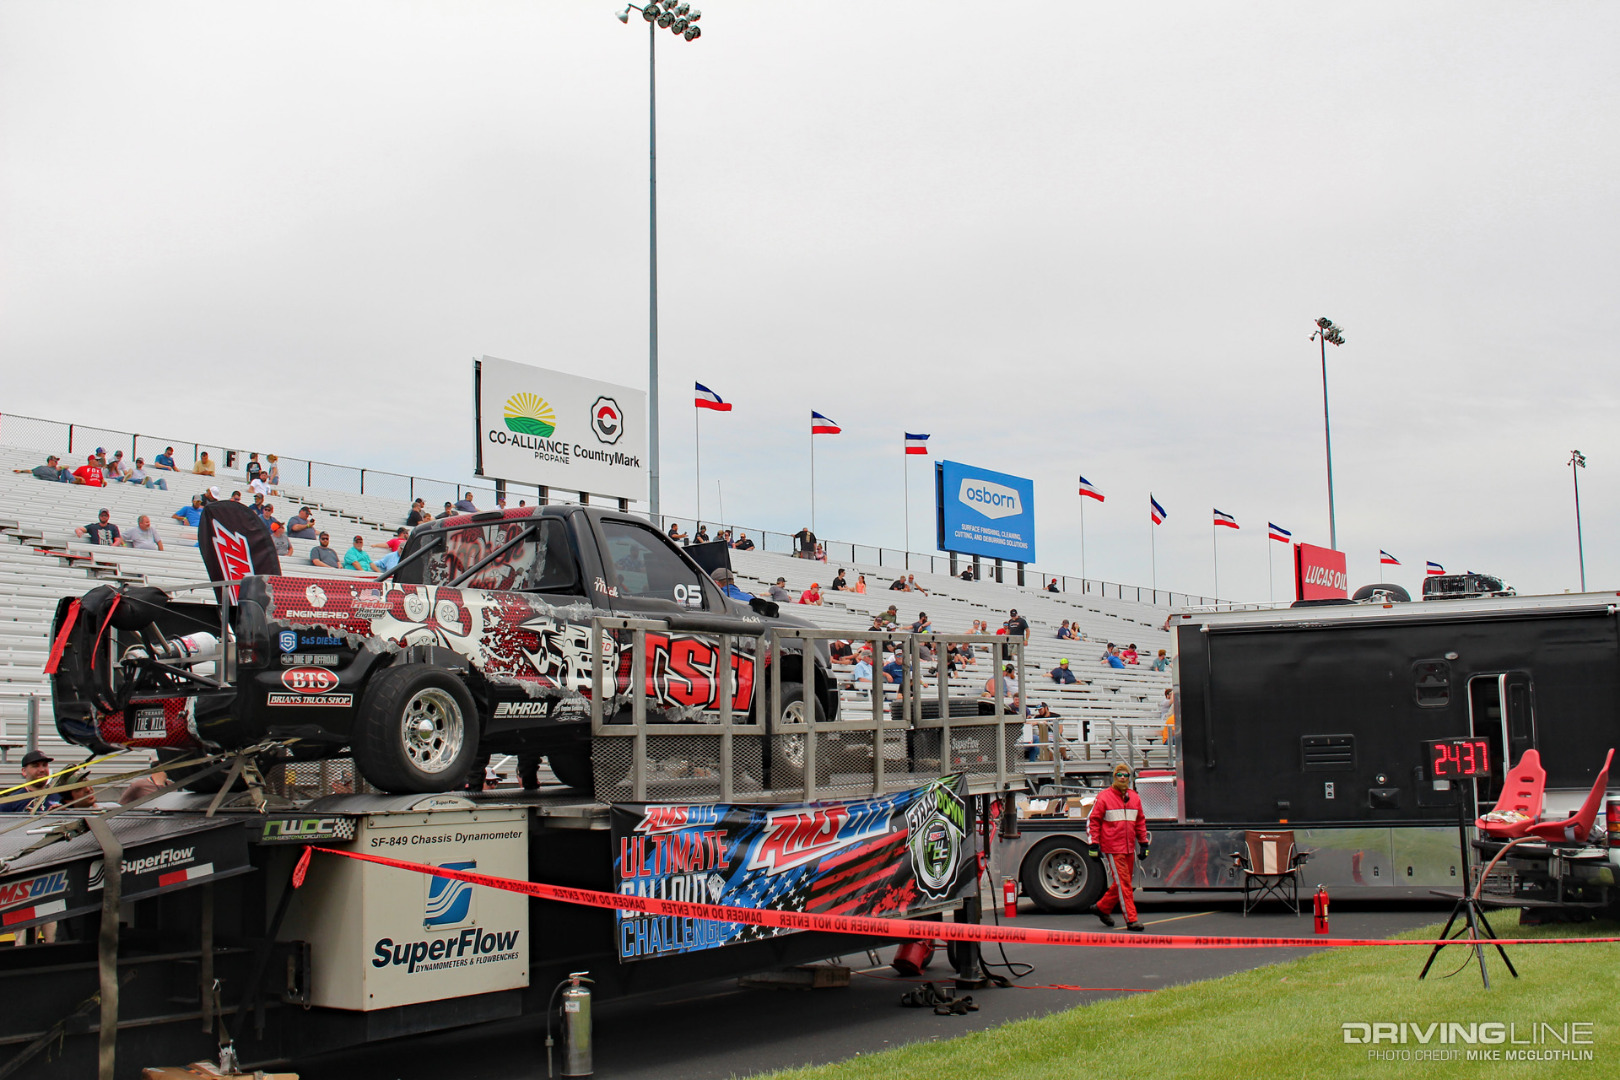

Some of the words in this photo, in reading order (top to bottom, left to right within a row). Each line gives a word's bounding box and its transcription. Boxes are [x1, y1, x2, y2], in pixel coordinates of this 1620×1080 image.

[488, 430, 570, 456] CO-ALLIANCE
[226, 450, 236, 468] F
[534, 451, 570, 464] PROPANE
[573, 445, 641, 468] CountryMark
[966, 486, 1015, 509] osborn
[954, 530, 974, 540] CUTTING,
[974, 533, 982, 541] AND
[983, 536, 1006, 546] DEBURRING
[961, 524, 980, 534] SURFACE
[1304, 565, 1334, 588] LUCAS
[1334, 572, 1348, 591] OIL
[674, 584, 702, 604] 05
[286, 610, 350, 620] ENGINEERED
[351, 600, 394, 610] Freedom
[316, 636, 342, 646] DIESEL
[294, 655, 305, 664] ONE
[305, 655, 314, 664] UP
[314, 655, 338, 664] OFFROAD
[292, 672, 330, 688] BTS
[301, 696, 327, 704] TRUCK
[504, 702, 548, 714] NHRDA
[1083, 720, 1091, 742] F
[1435, 742, 1488, 775] 2437
[634, 804, 718, 835] AMSOIL
[909, 785, 938, 837] STRAP
[936, 787, 964, 831] DOWN
[371, 836, 408, 848] SF-849
[411, 834, 452, 845] Chassis
[455, 830, 523, 844] Dynamometer
[746, 799, 896, 877] AMSOIL
[120, 846, 196, 875] SuperFlow
[621, 830, 730, 878] ULTIMATE
[621, 915, 729, 958] CHALLENGE
[372, 928, 520, 974] SuperFlow
[415, 960, 468, 973] DYNAMOMETERS
[476, 952, 520, 964] FLOWBENCHES
